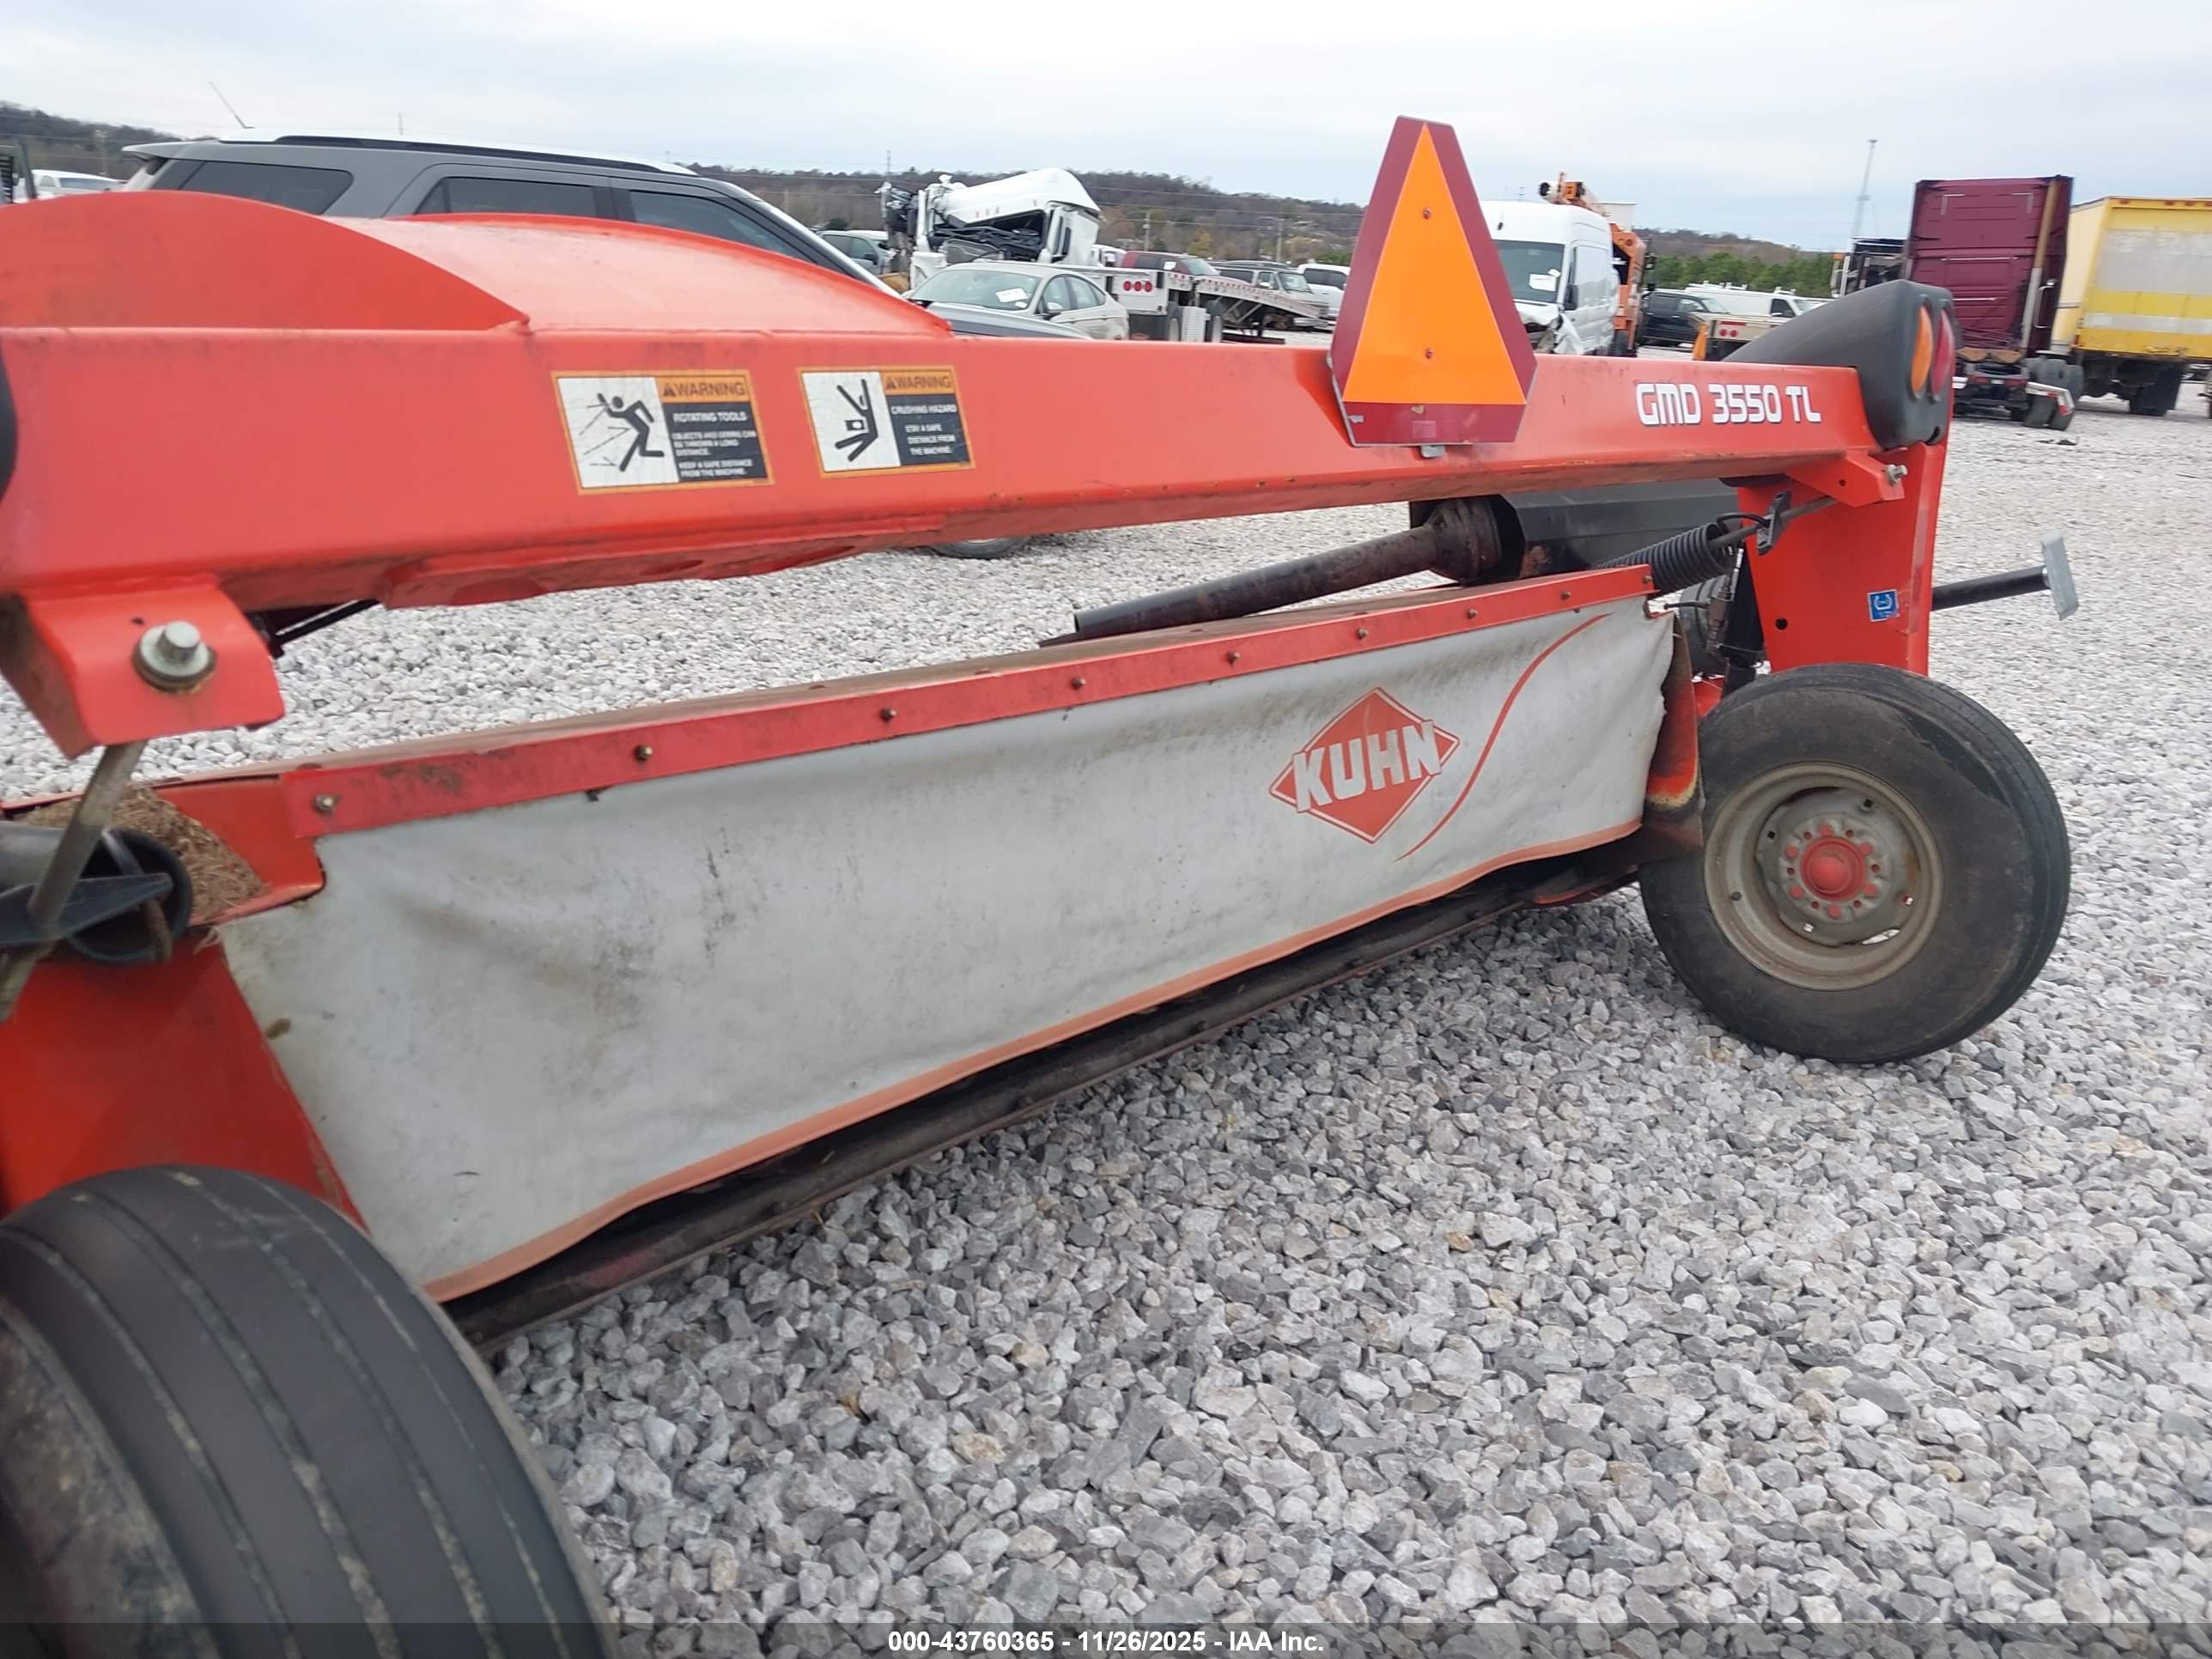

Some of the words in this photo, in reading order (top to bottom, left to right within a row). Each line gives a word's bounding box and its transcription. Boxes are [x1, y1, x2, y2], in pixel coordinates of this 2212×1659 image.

[896, 375, 951, 389] WARNING
[674, 382, 746, 397] WARNING
[890, 405, 928, 415] CRUSHING
[928, 404, 957, 413] HAZARD
[1635, 383, 1702, 426] GMD
[1707, 384, 1783, 423] 3550
[1784, 386, 1822, 422] TL
[672, 413, 717, 423] ROTATING
[717, 411, 748, 422] TOOLS
[926, 423, 943, 432] SAFE
[1292, 719, 1443, 813] KUHN
